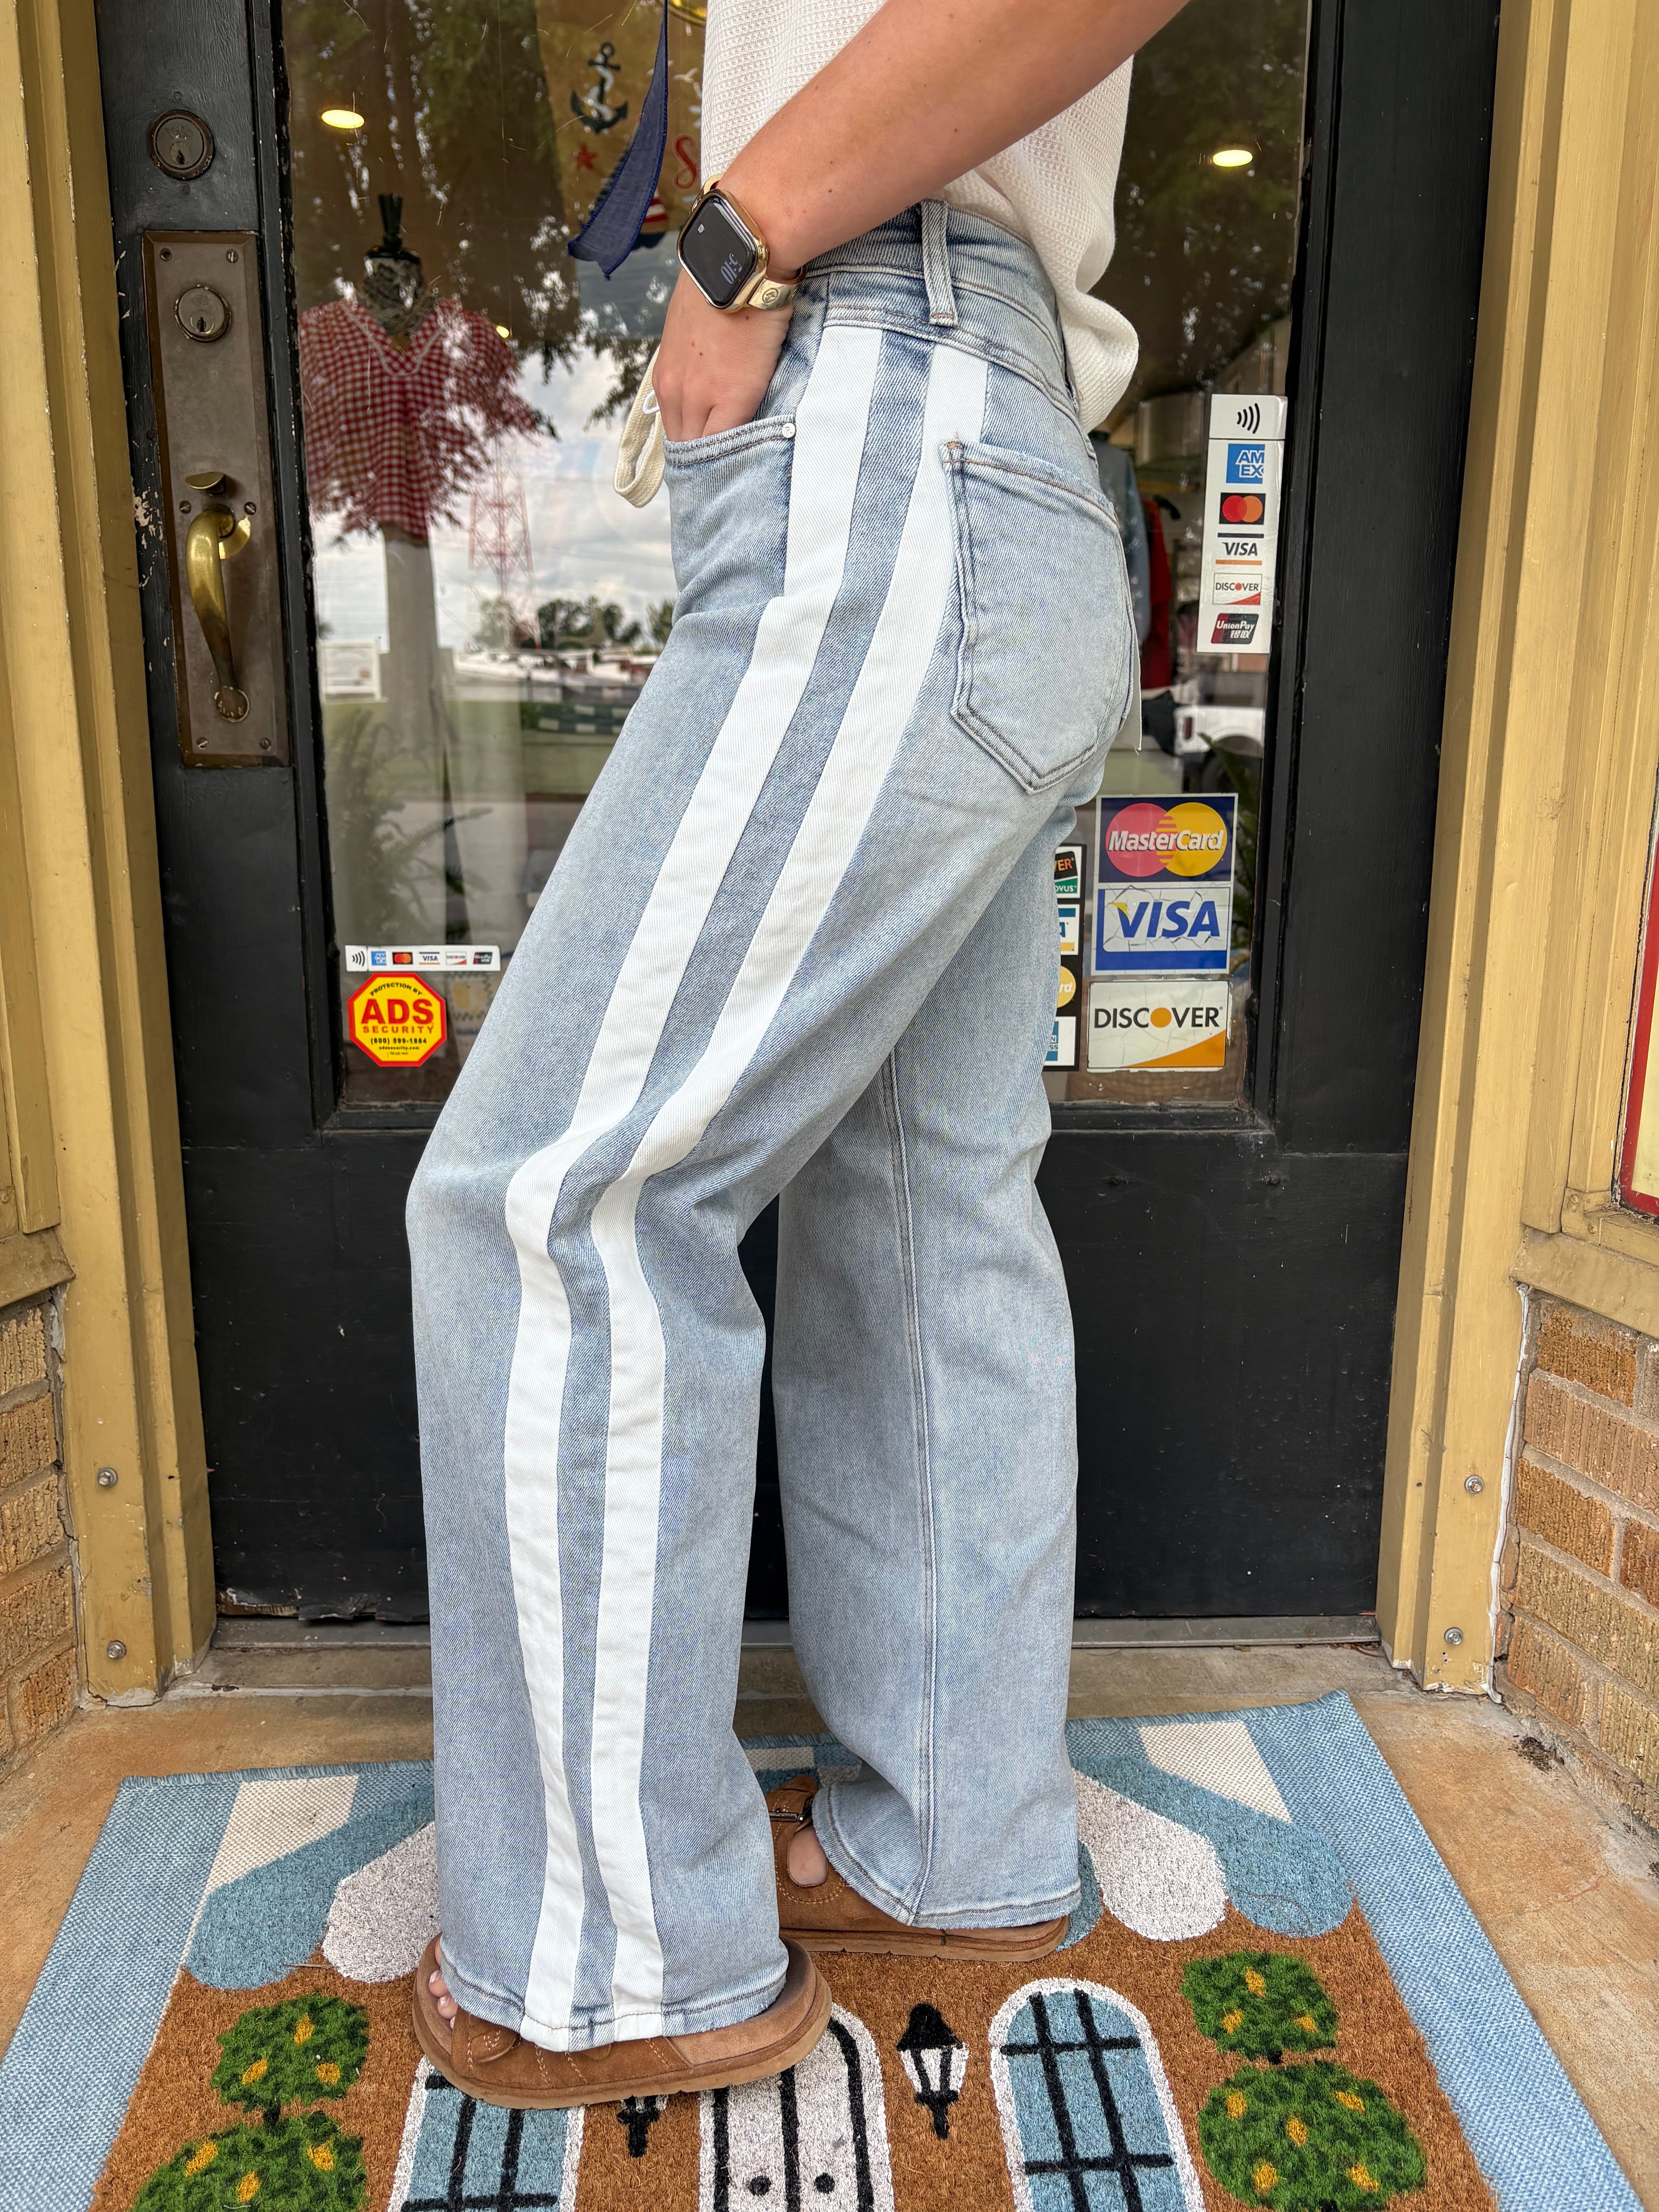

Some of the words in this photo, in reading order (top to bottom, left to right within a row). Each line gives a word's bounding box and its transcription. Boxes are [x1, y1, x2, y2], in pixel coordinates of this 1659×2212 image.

[721, 253, 742, 284] 5:10
[1236, 450, 1265, 464] AM
[1239, 464, 1264, 477] EX
[1222, 542, 1258, 556] VISA
[1215, 582, 1259, 591] DISCOVER
[1216, 620, 1255, 634] UnionPay
[1108, 830, 1224, 852] MasterCard
[1109, 901, 1220, 938] VISA
[370, 982, 412, 996] PROTECTION
[361, 999, 434, 1024] ADS
[1094, 1007, 1219, 1029] DISCOVER
